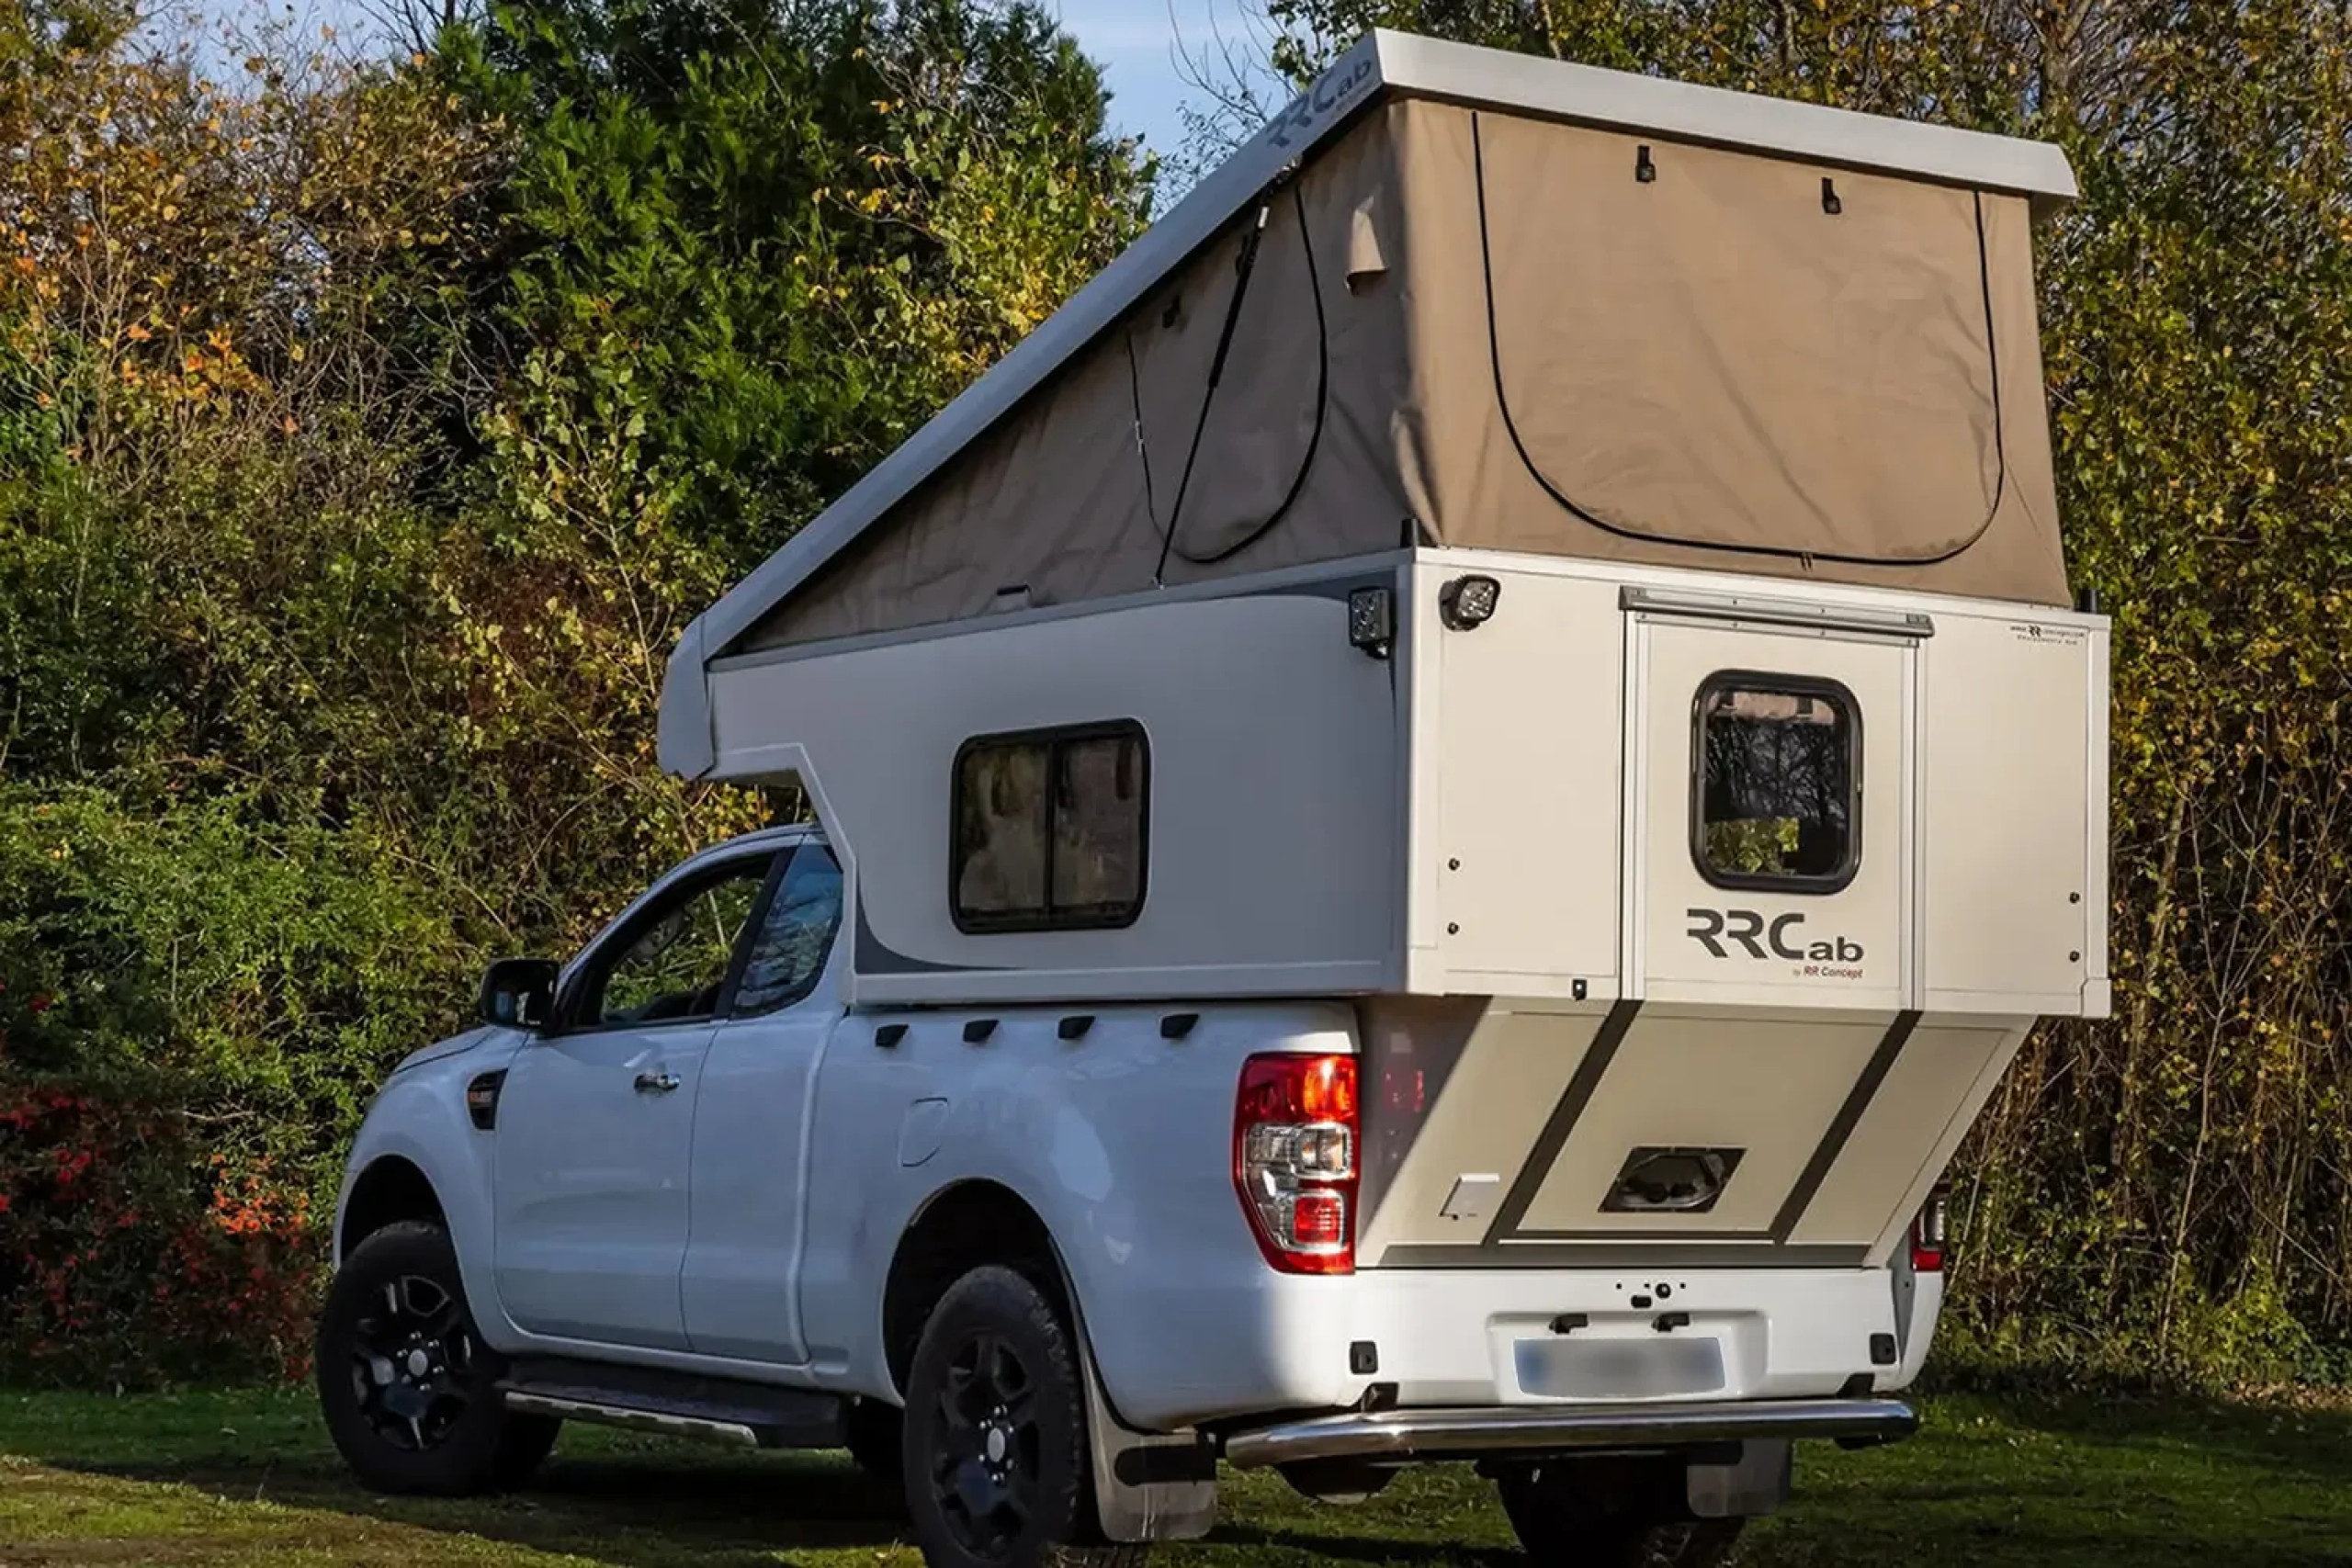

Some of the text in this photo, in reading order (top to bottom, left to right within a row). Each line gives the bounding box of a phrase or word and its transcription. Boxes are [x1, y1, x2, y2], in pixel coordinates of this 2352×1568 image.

[1687, 908, 1864, 962] RRCab
[1804, 965, 1819, 976] RR
[1821, 966, 1863, 979] Concept
